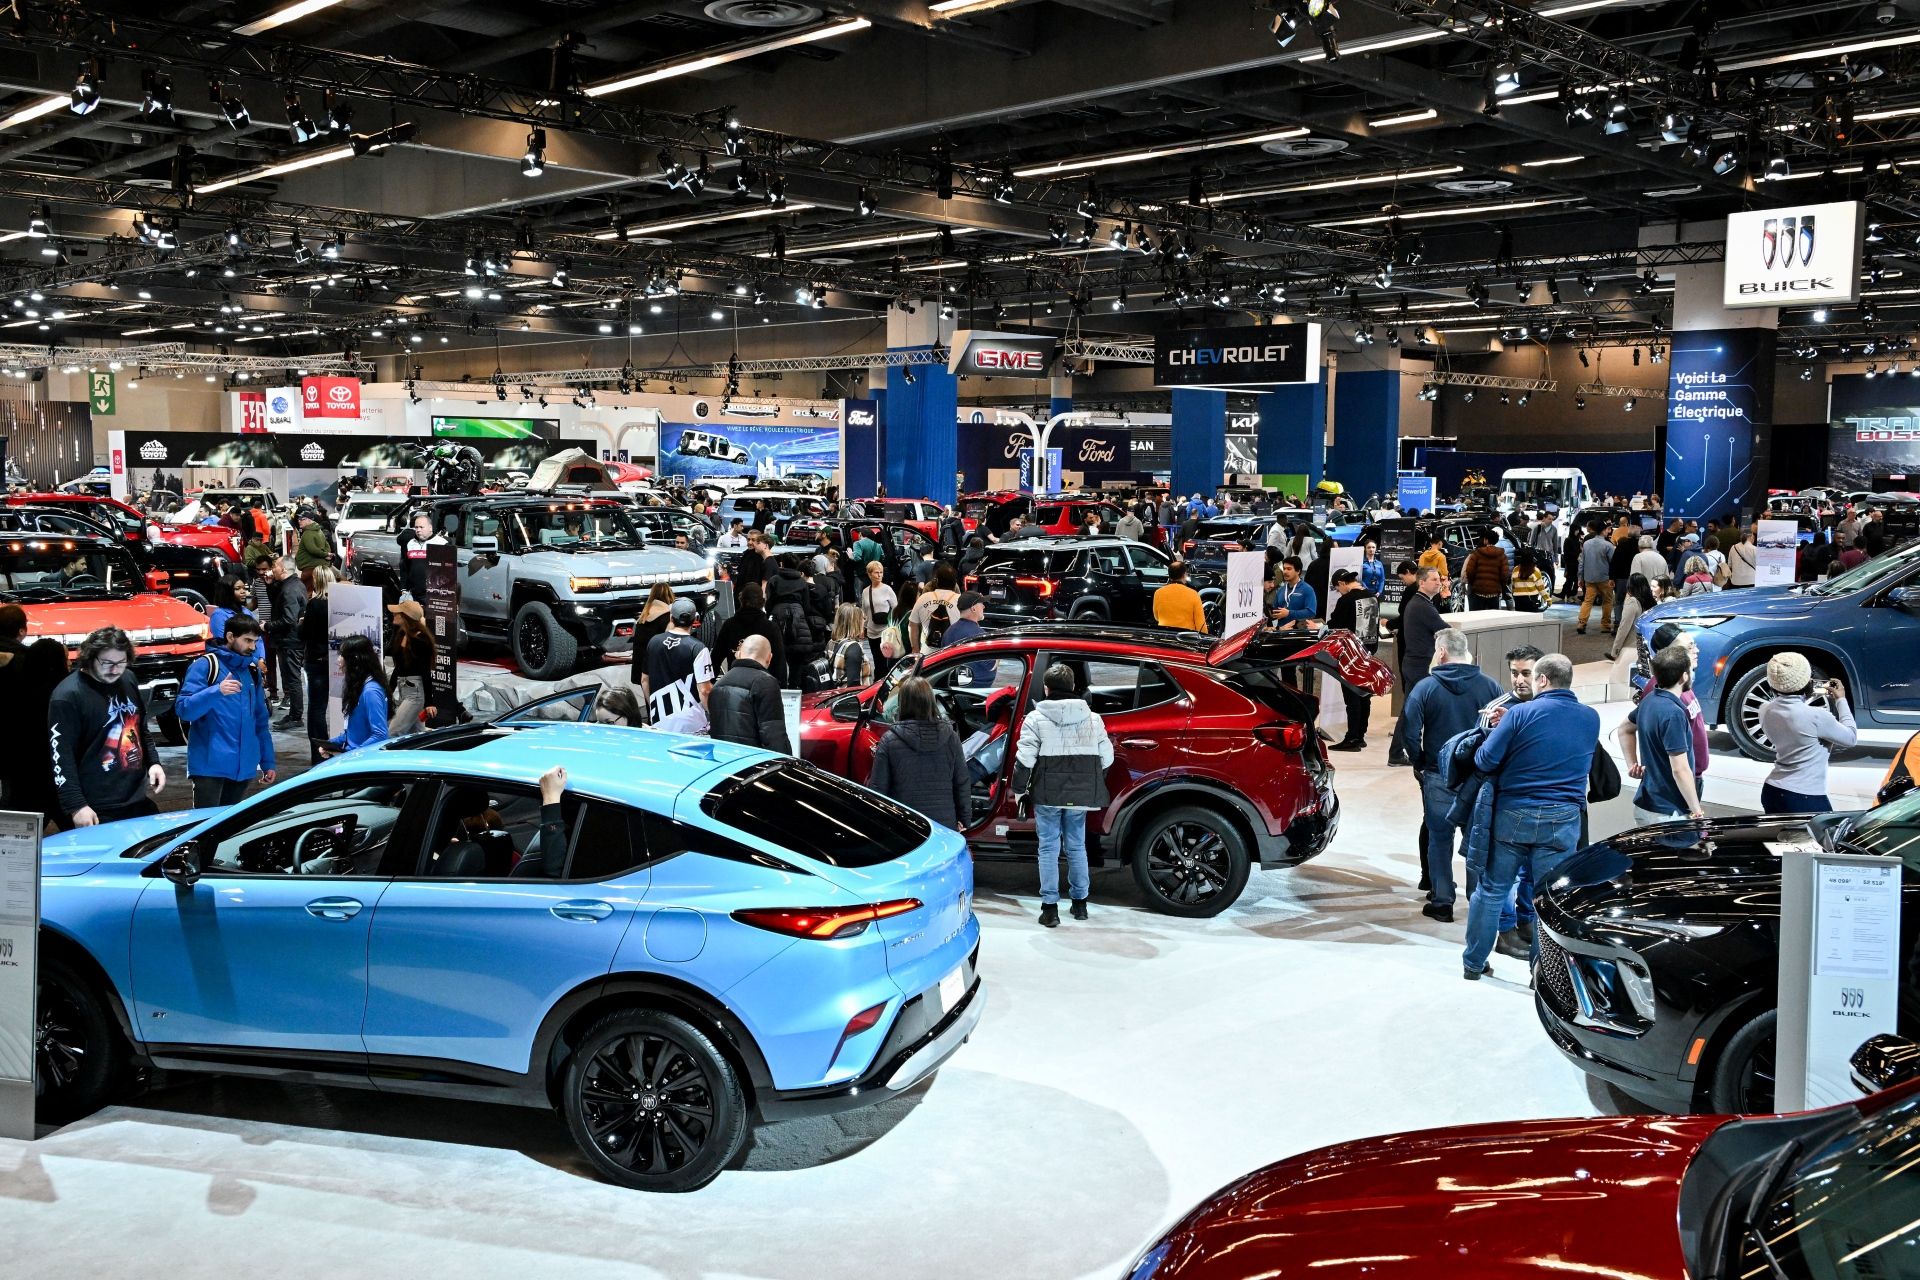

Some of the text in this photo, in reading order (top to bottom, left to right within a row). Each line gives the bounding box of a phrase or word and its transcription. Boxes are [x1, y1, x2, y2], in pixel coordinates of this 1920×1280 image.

[1739, 277, 1835, 295] BUICK
[974, 348, 1043, 370] GMC
[1169, 345, 1289, 367] CHEVROLET
[1676, 371, 1727, 384] Voici La
[1675, 389, 1727, 401] Gamme
[326, 402, 356, 410] TOYOTA
[1674, 403, 1743, 419] Électrique
[269, 417, 292, 425] SUBARU
[848, 410, 874, 426] Ford
[1078, 438, 1115, 462] Ford
[1020, 452, 1031, 488] Ford
[1232, 611, 1257, 619] BUICK
[1832, 1010, 1871, 1018] BUICK
